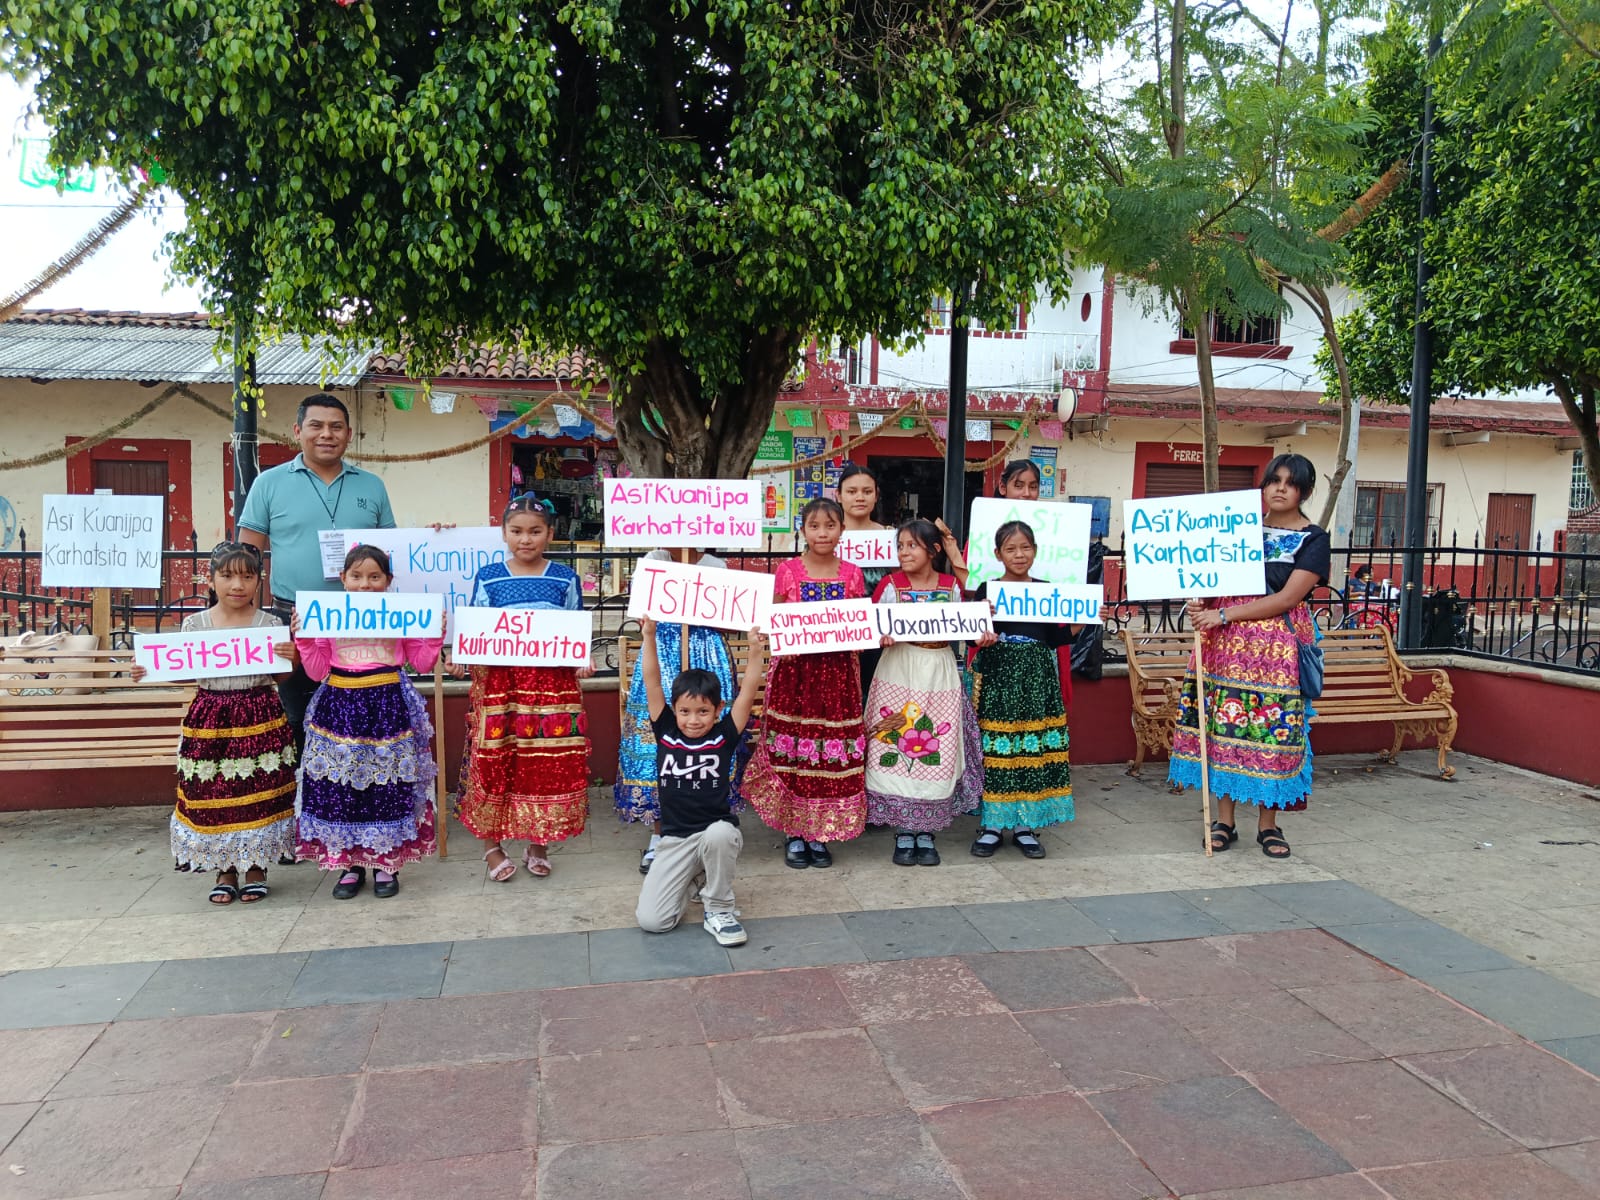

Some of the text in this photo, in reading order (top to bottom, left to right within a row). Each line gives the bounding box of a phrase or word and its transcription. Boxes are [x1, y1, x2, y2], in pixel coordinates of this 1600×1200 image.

[1173, 449, 1204, 462] FERRE
[611, 483, 653, 504] Asï
[47, 506, 73, 531] Asï
[729, 516, 755, 536] ixu
[1132, 509, 1173, 534] Asï
[137, 548, 158, 568] ixu
[1177, 568, 1218, 589] ixu
[303, 594, 432, 636] Anhatapu
[996, 587, 1097, 622] Anhatapu
[494, 611, 534, 634] Asï
[876, 608, 987, 635] Uaxantskua
[771, 625, 872, 651] Jurhamukua
[143, 636, 274, 670] Tsïtsïki
[660, 754, 720, 779] AIR
[661, 778, 719, 790] NIKE
